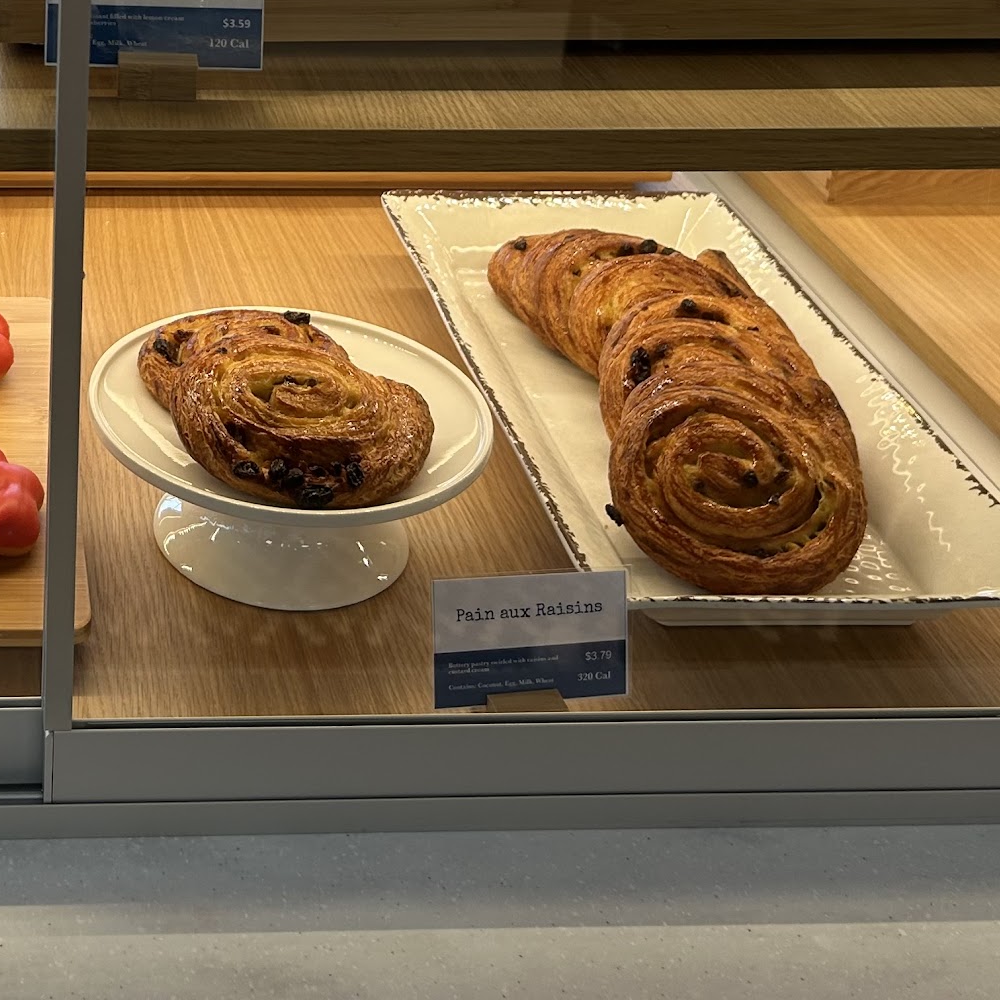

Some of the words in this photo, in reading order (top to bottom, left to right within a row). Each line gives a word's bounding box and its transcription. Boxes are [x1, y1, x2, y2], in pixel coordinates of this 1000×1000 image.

[222, 18, 251, 29] $3.59
[209, 37, 228, 48] 120
[230, 38, 249, 49] Cal
[456, 607, 495, 622] Pain
[500, 607, 531, 619] aux
[536, 600, 603, 617] Raisins
[585, 650, 612, 661] $3.79
[577, 672, 594, 681] 320
[595, 671, 611, 680] Cal
